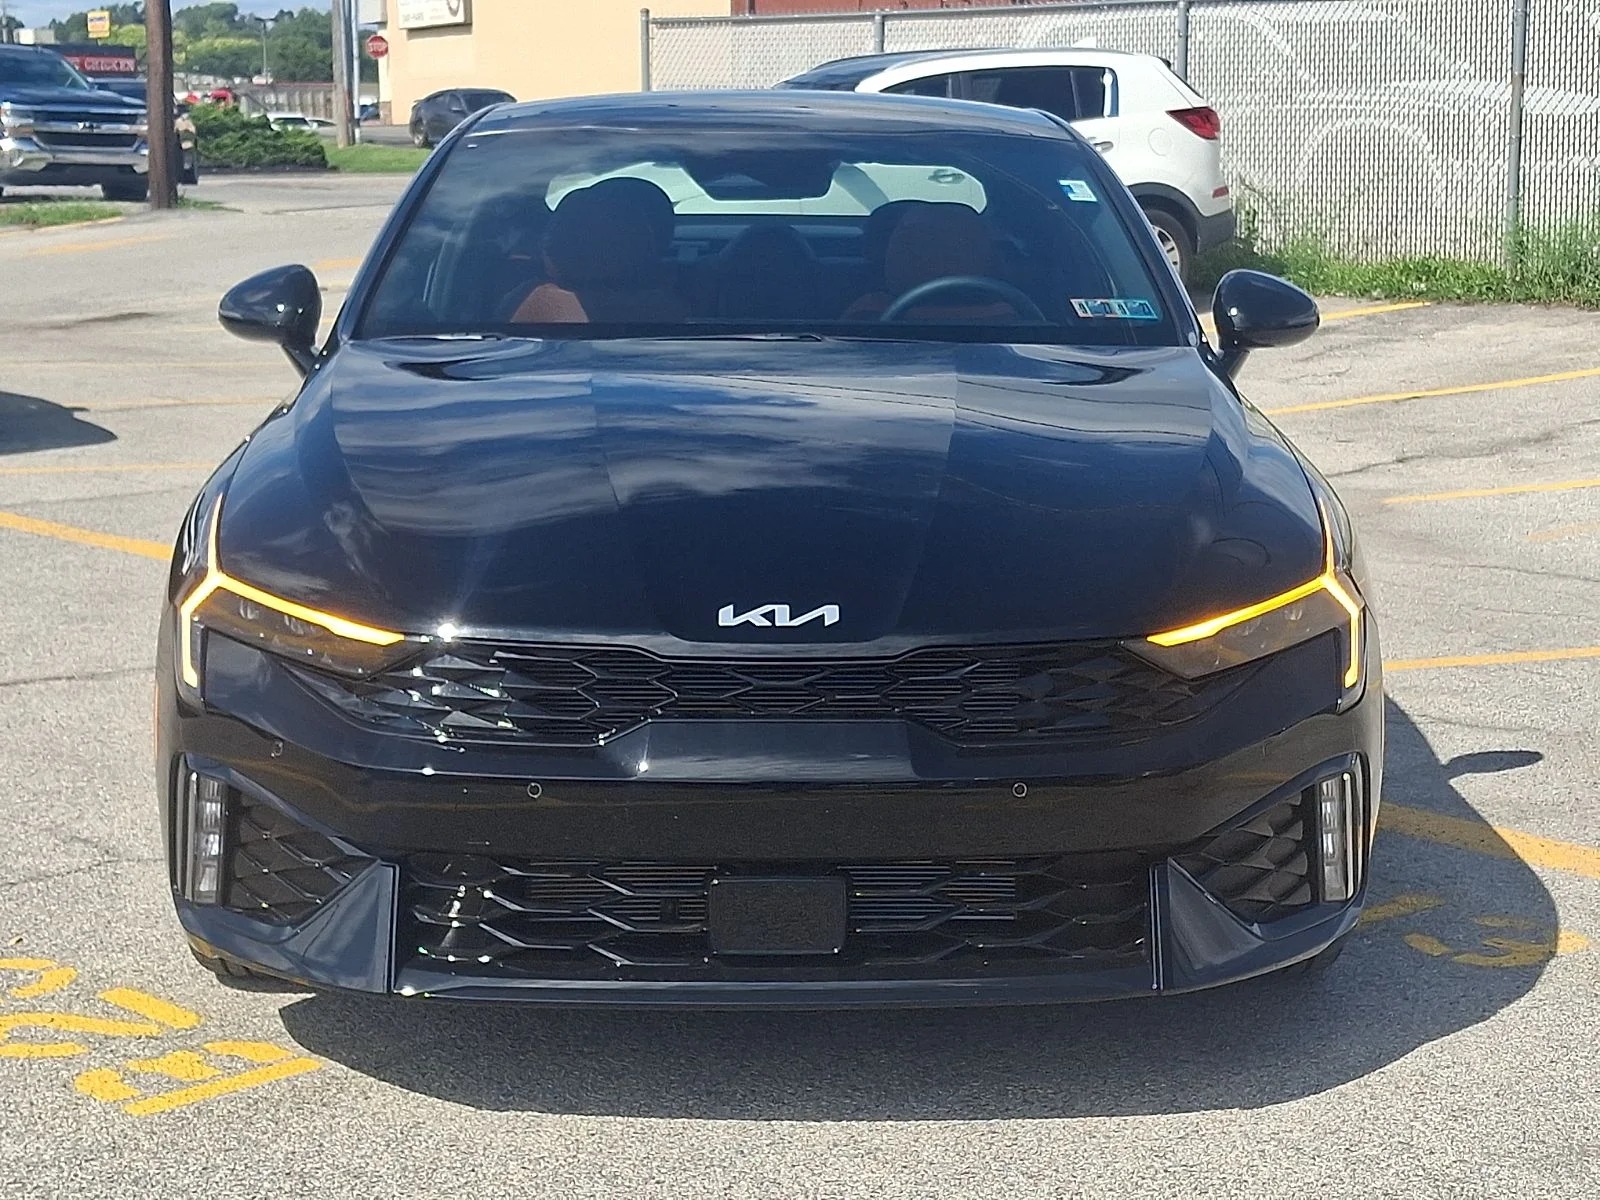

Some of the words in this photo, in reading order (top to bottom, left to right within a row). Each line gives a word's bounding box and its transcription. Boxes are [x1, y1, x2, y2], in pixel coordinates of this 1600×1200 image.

[368, 42, 387, 52] STOP
[85, 57, 135, 72] CHICKEN
[718, 604, 840, 627] KIA
